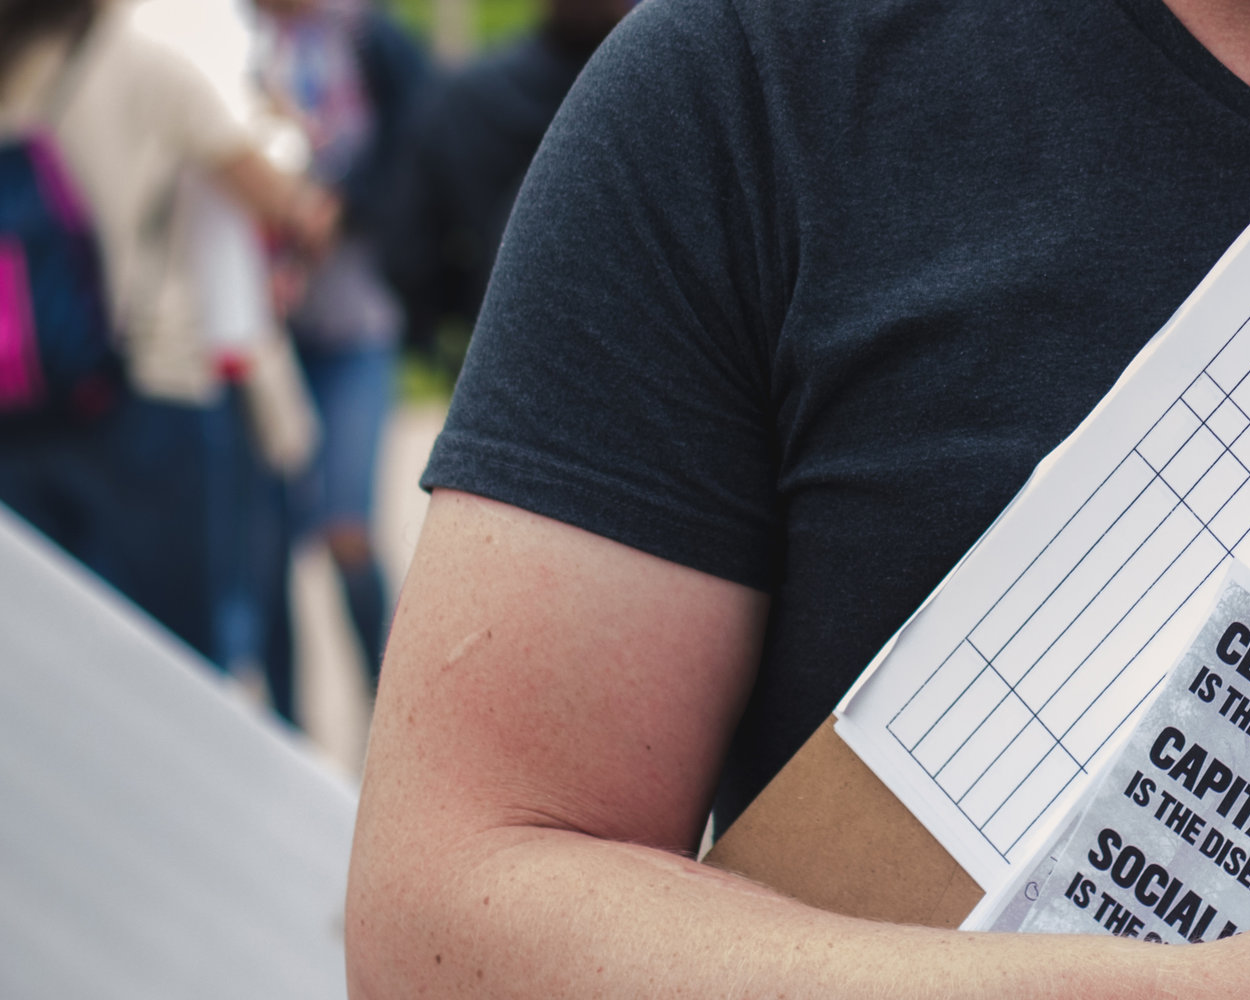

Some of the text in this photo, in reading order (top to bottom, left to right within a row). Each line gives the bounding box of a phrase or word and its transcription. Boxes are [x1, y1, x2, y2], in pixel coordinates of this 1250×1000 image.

[1188, 665, 1223, 703] IS
[1123, 770, 1157, 807] IS
[1154, 790, 1207, 846] THE
[1064, 871, 1146, 938] IS THE
